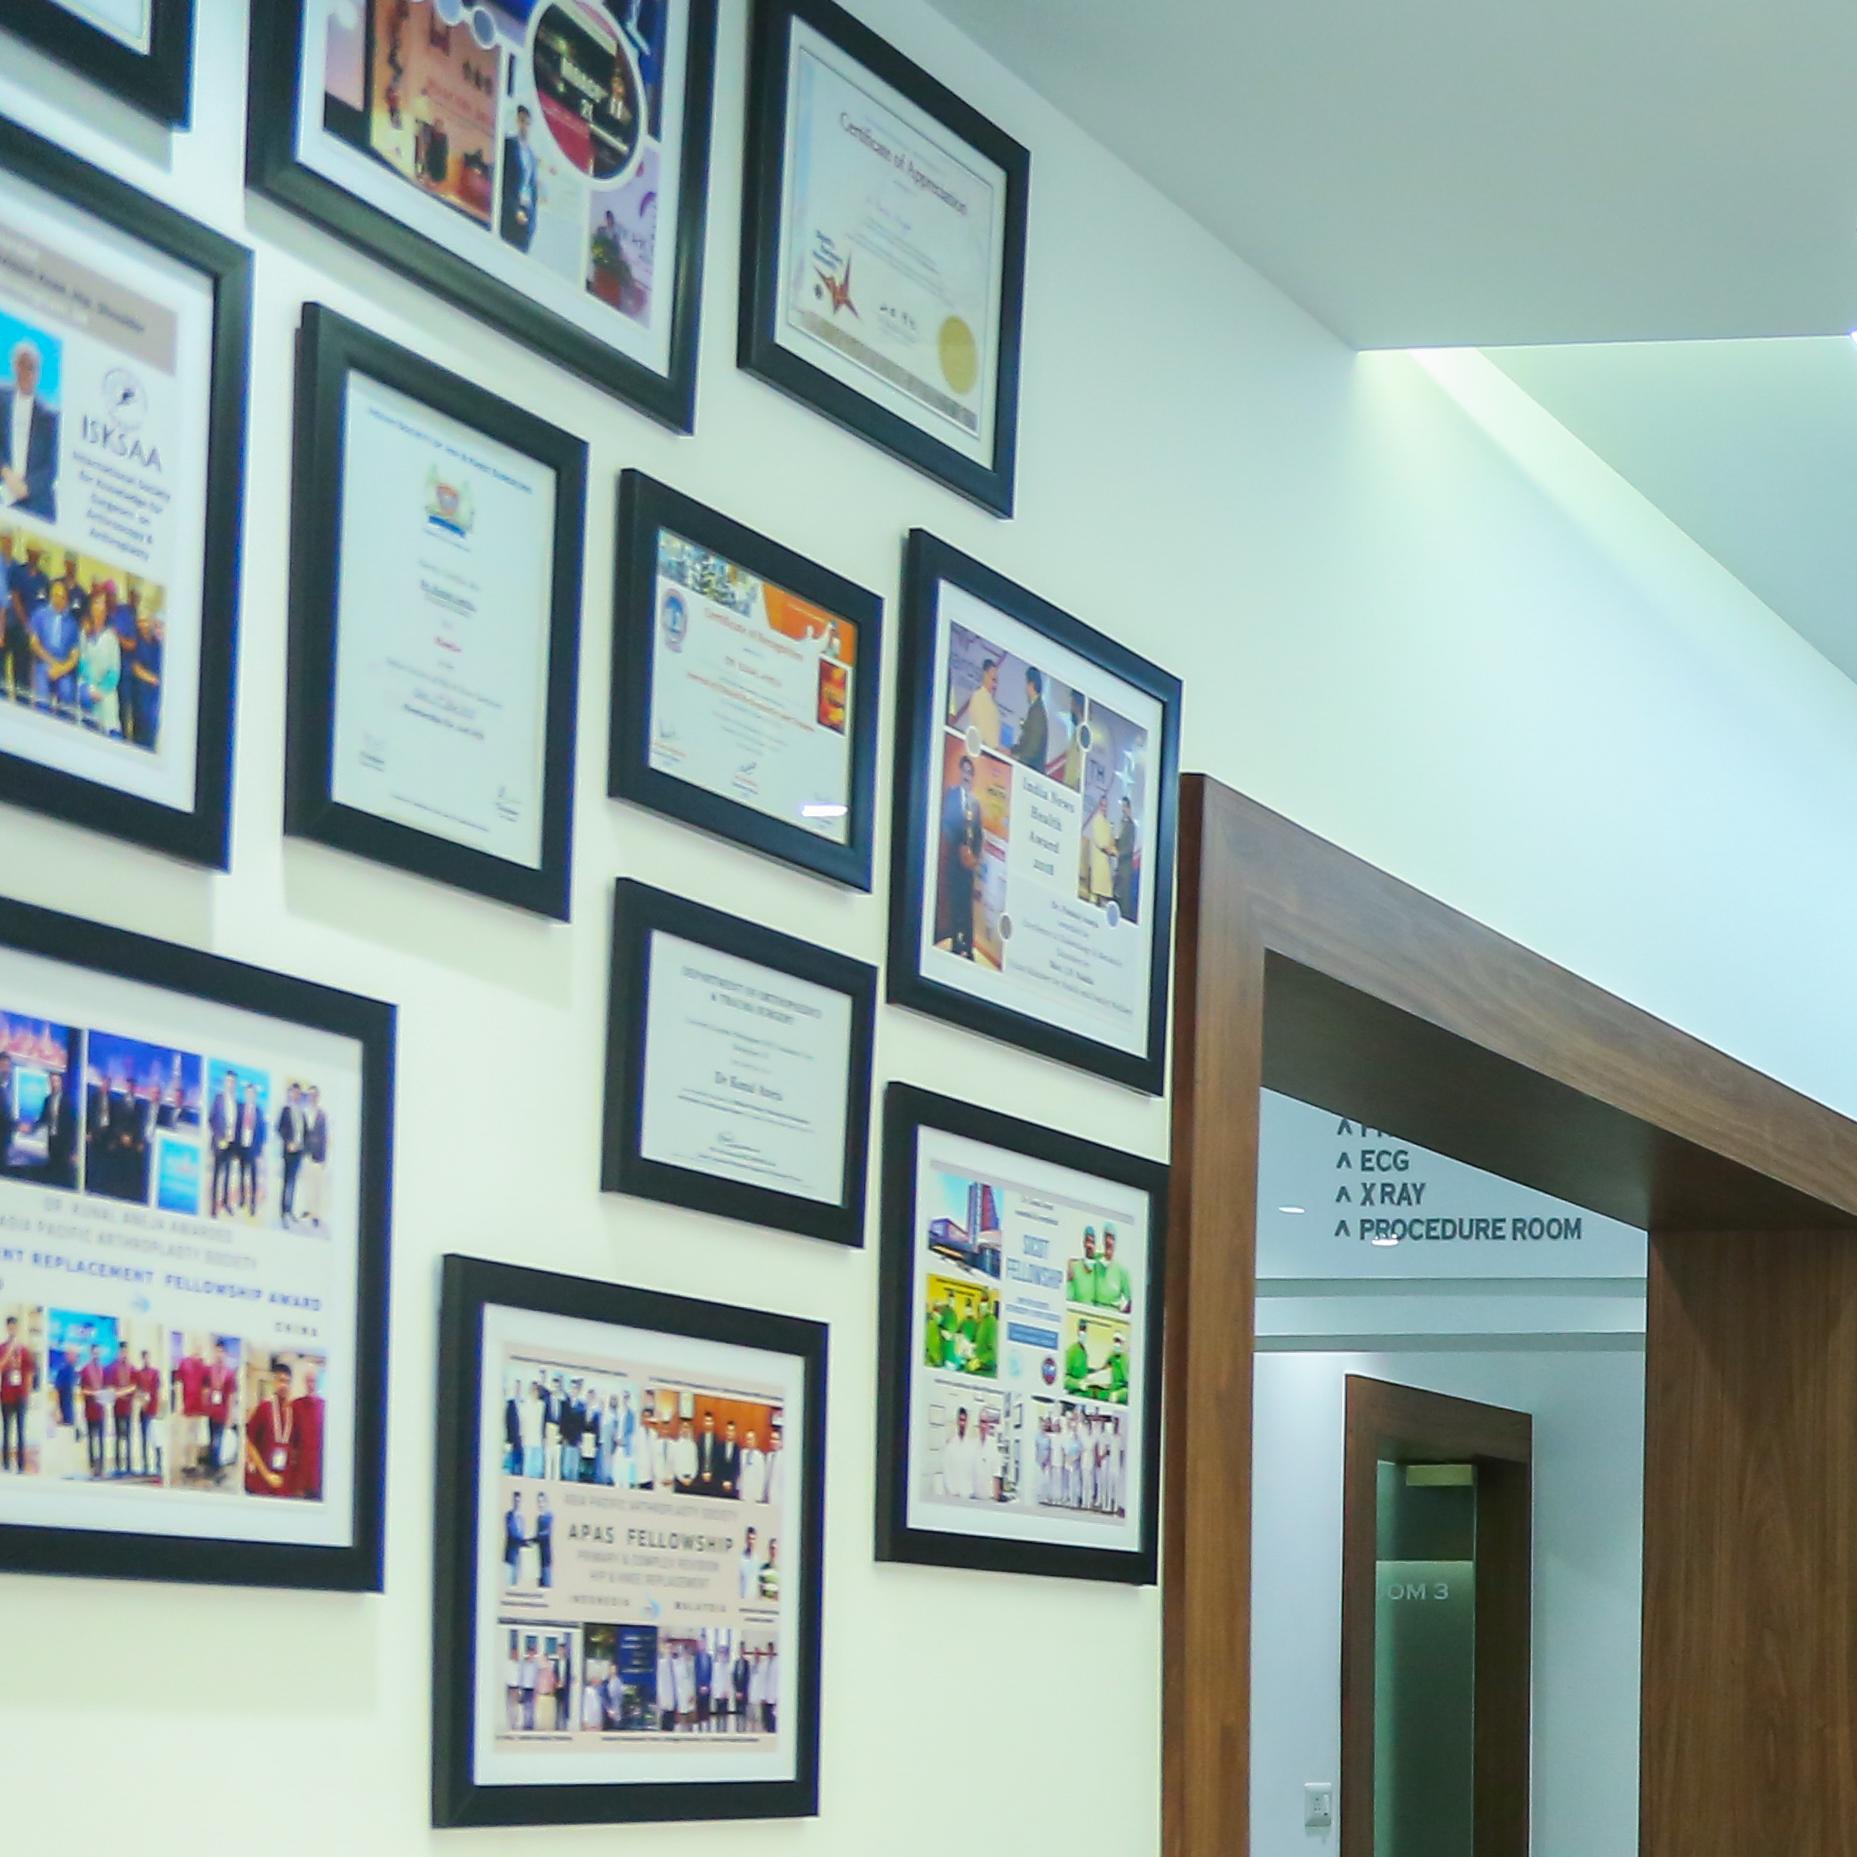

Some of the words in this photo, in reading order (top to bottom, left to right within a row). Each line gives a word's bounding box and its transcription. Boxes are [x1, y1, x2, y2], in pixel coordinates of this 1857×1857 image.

[82, 414, 162, 473] ISKSAA
[1023, 777, 1048, 801] India
[1050, 791, 1076, 814] News
[1031, 805, 1063, 832] Health
[1029, 831, 1061, 855] Award
[1361, 1149, 1409, 1172] ECG
[1359, 1217, 1506, 1241] PROCEDURE
[1512, 1217, 1582, 1241] ROOM
[31, 1252, 155, 1285] REPLACEMENT
[164, 1273, 263, 1300] FELLOWSHIP
[268, 1292, 323, 1312] AWARD
[567, 1523, 616, 1545] APAS
[626, 1528, 735, 1554] FELLOWSHIP
[1433, 1582, 1449, 1600] 3
